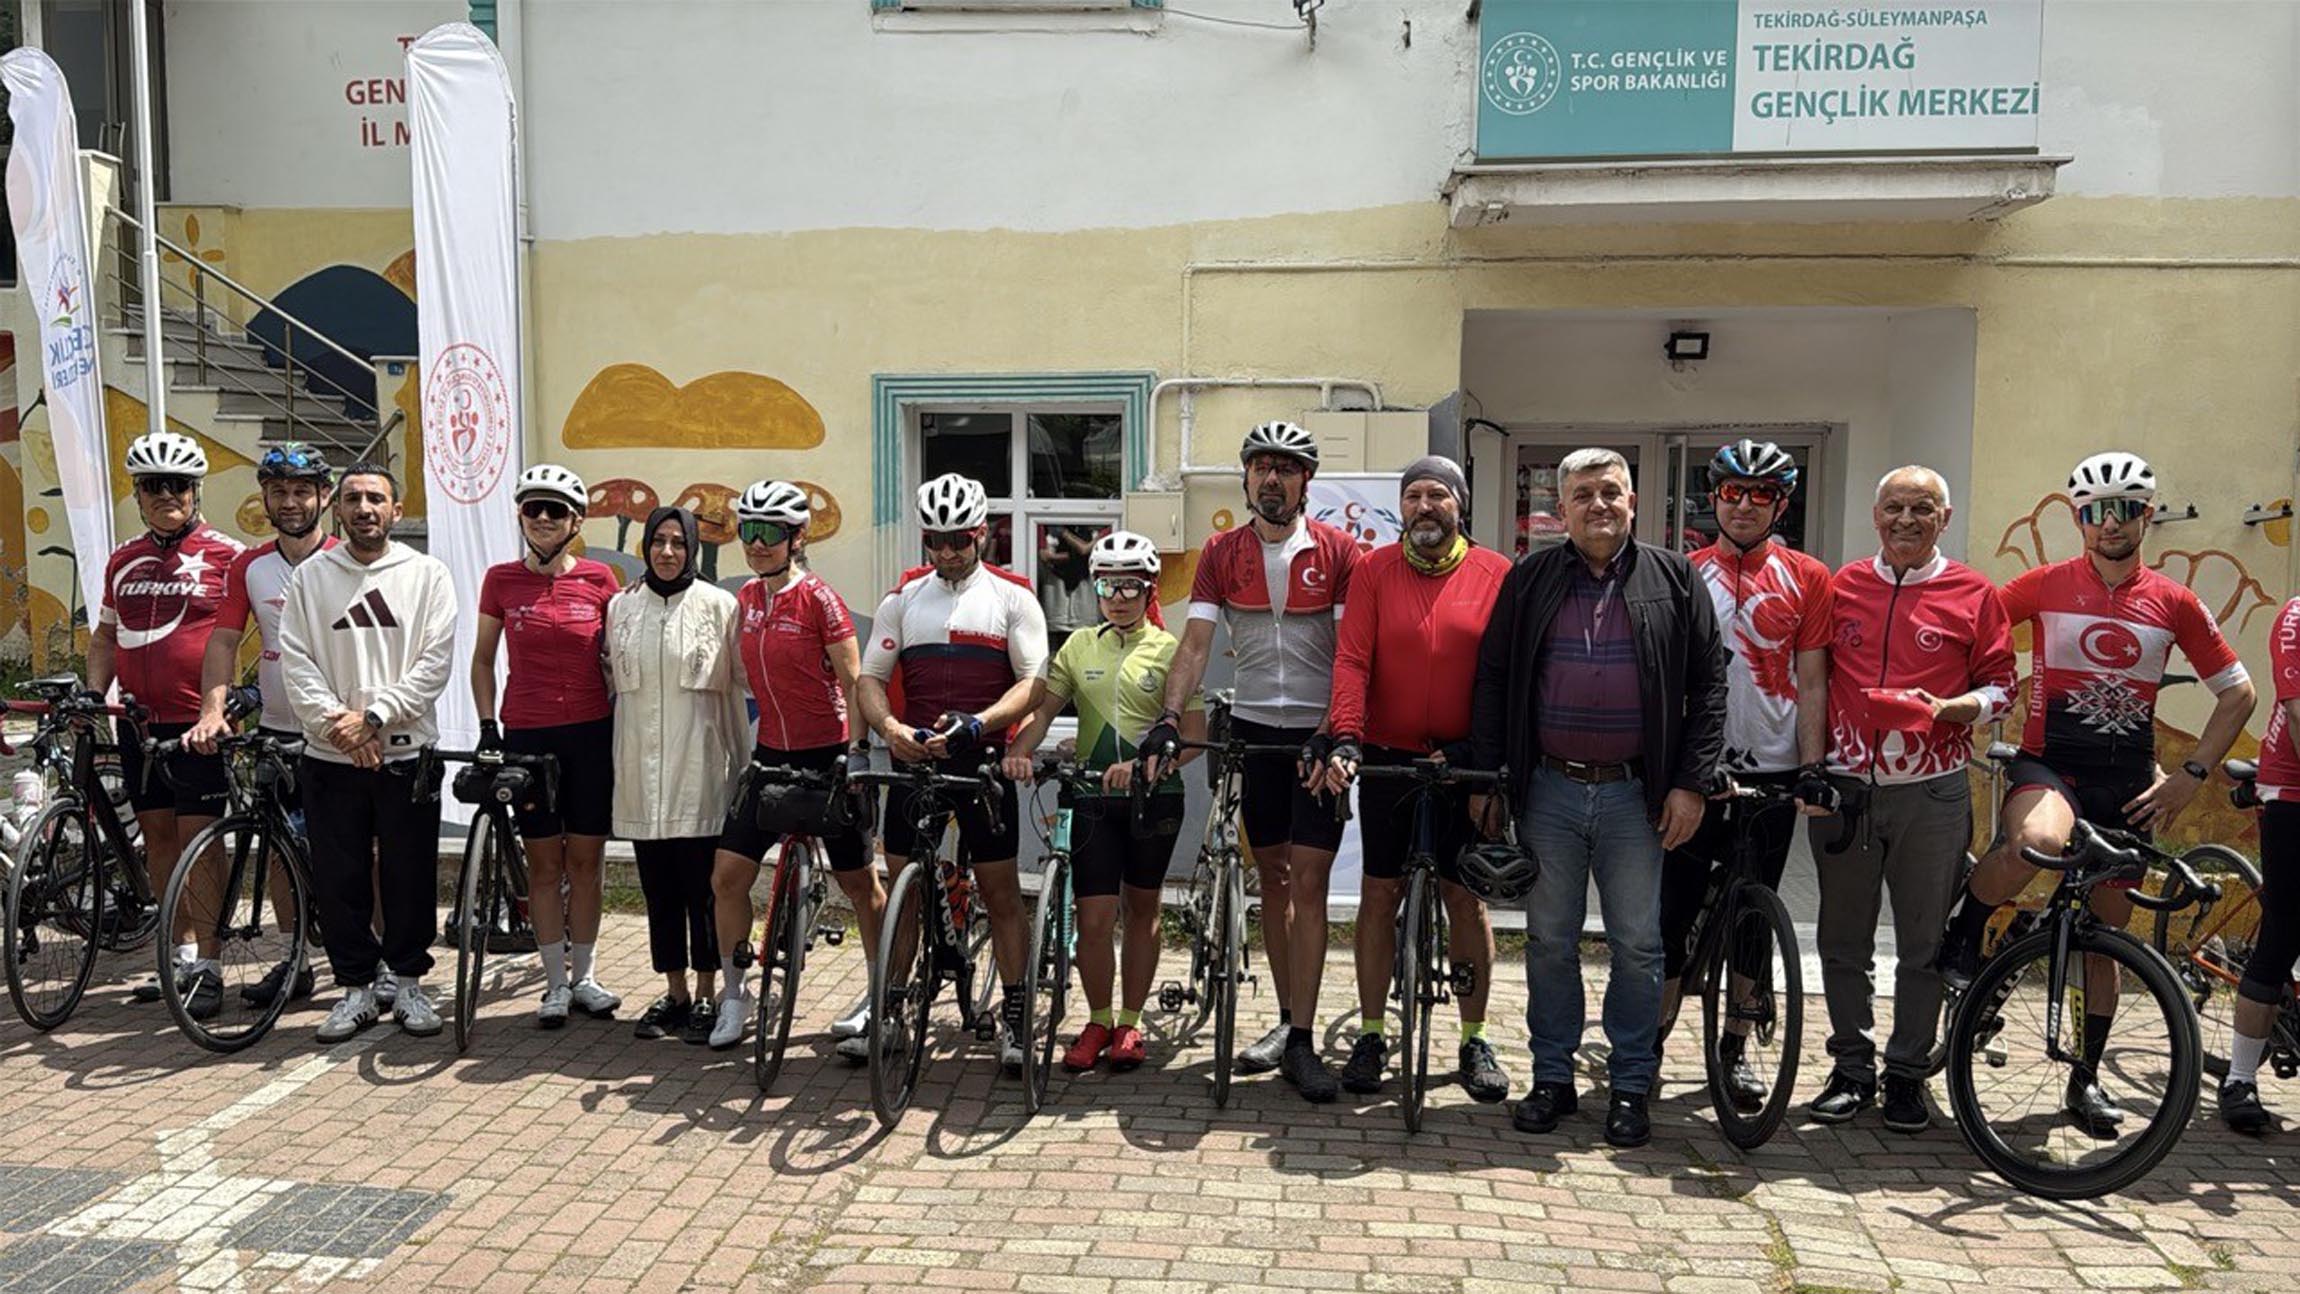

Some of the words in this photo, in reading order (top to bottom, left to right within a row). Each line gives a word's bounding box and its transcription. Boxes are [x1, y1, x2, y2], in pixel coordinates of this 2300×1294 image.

[1754, 9, 1988, 28] TEKİRDAĞ-SÜLEYMANPAŞA
[1571, 53, 1605, 69] T.C.
[1611, 48, 1695, 71] GENÇLİK
[1703, 51, 1727, 66] VE
[1752, 36, 1915, 71] TEKİRDAĞ
[1571, 75, 1619, 91] SPOR
[1625, 70, 1726, 90] BAKANLIĞI
[1750, 84, 1889, 124] GENÇLİK
[1897, 82, 2039, 116] MERKEZİ
[361, 116, 386, 147] İL
